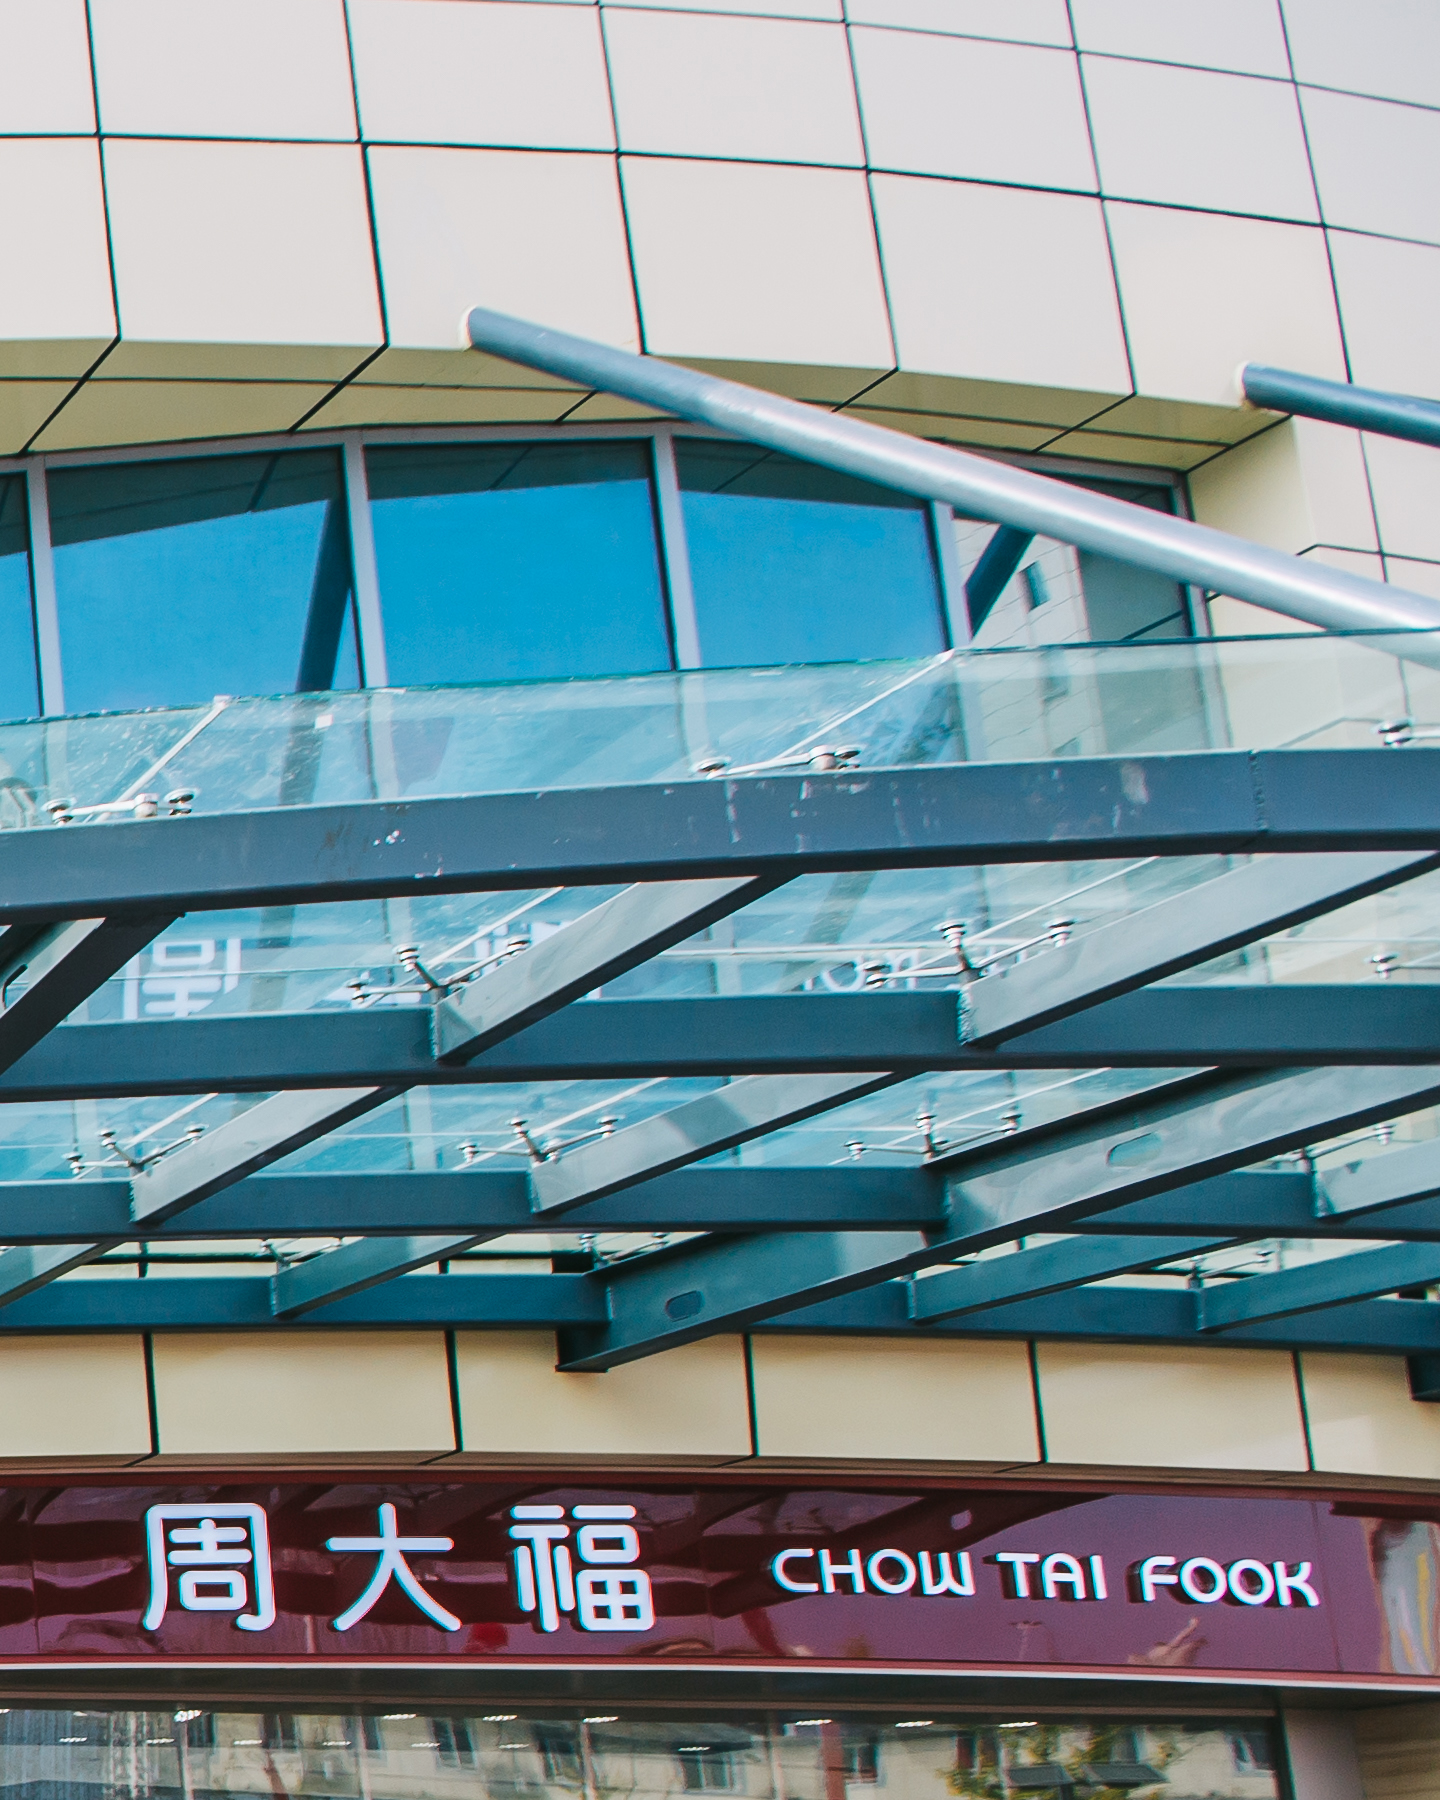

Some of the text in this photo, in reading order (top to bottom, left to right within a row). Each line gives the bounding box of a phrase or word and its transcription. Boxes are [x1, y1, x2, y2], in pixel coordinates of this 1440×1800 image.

[143, 1502, 655, 1632] 周大福
[771, 1548, 1320, 1607] CHOW TAI FOOK
